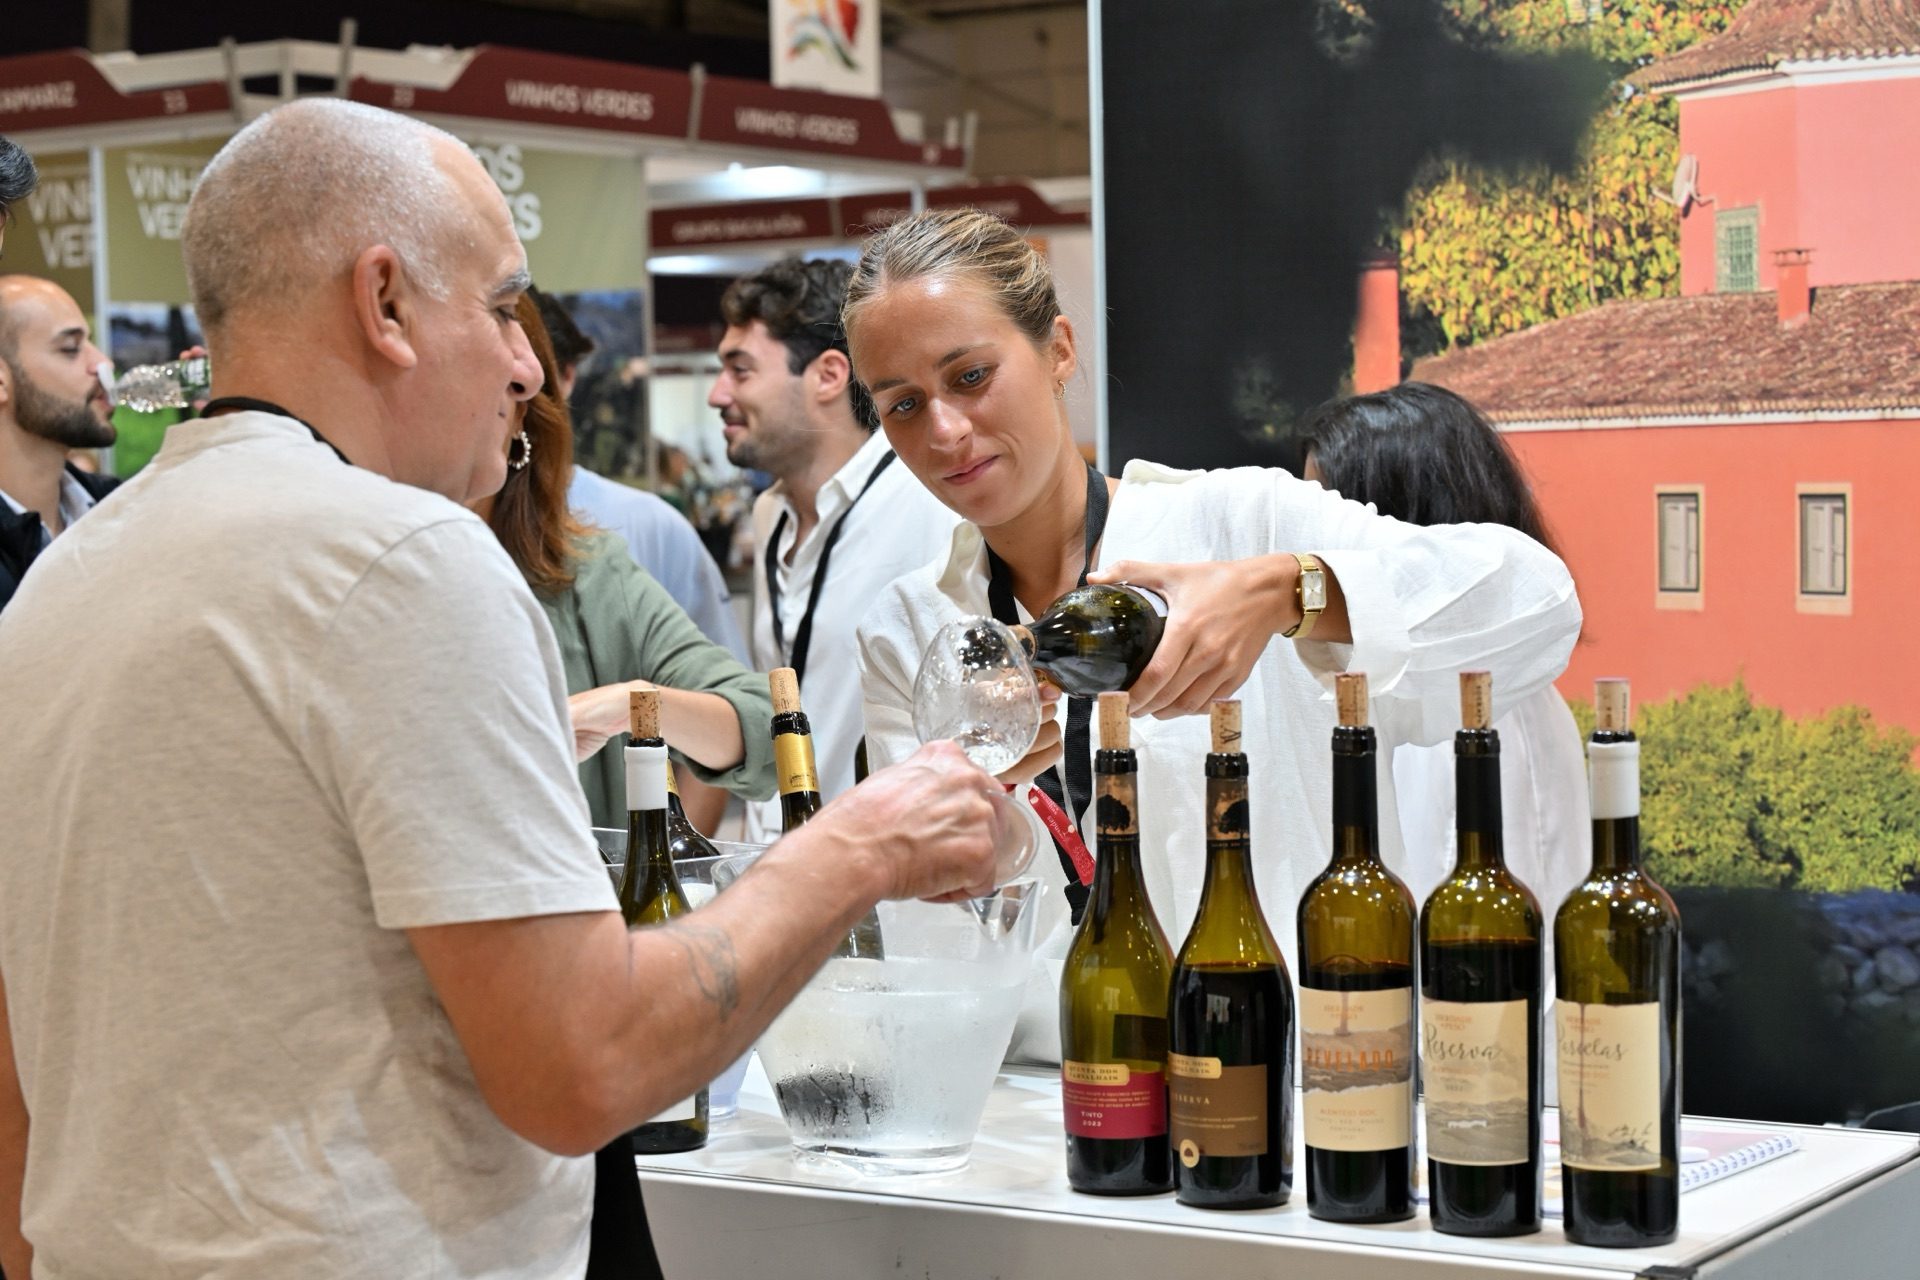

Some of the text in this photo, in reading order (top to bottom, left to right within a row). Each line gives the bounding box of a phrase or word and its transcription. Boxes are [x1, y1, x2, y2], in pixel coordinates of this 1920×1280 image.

[504, 78, 655, 122] VINHOS VERDES
[1306, 1046, 1394, 1073] REVELADO
[1424, 1021, 1498, 1061] Reserva
